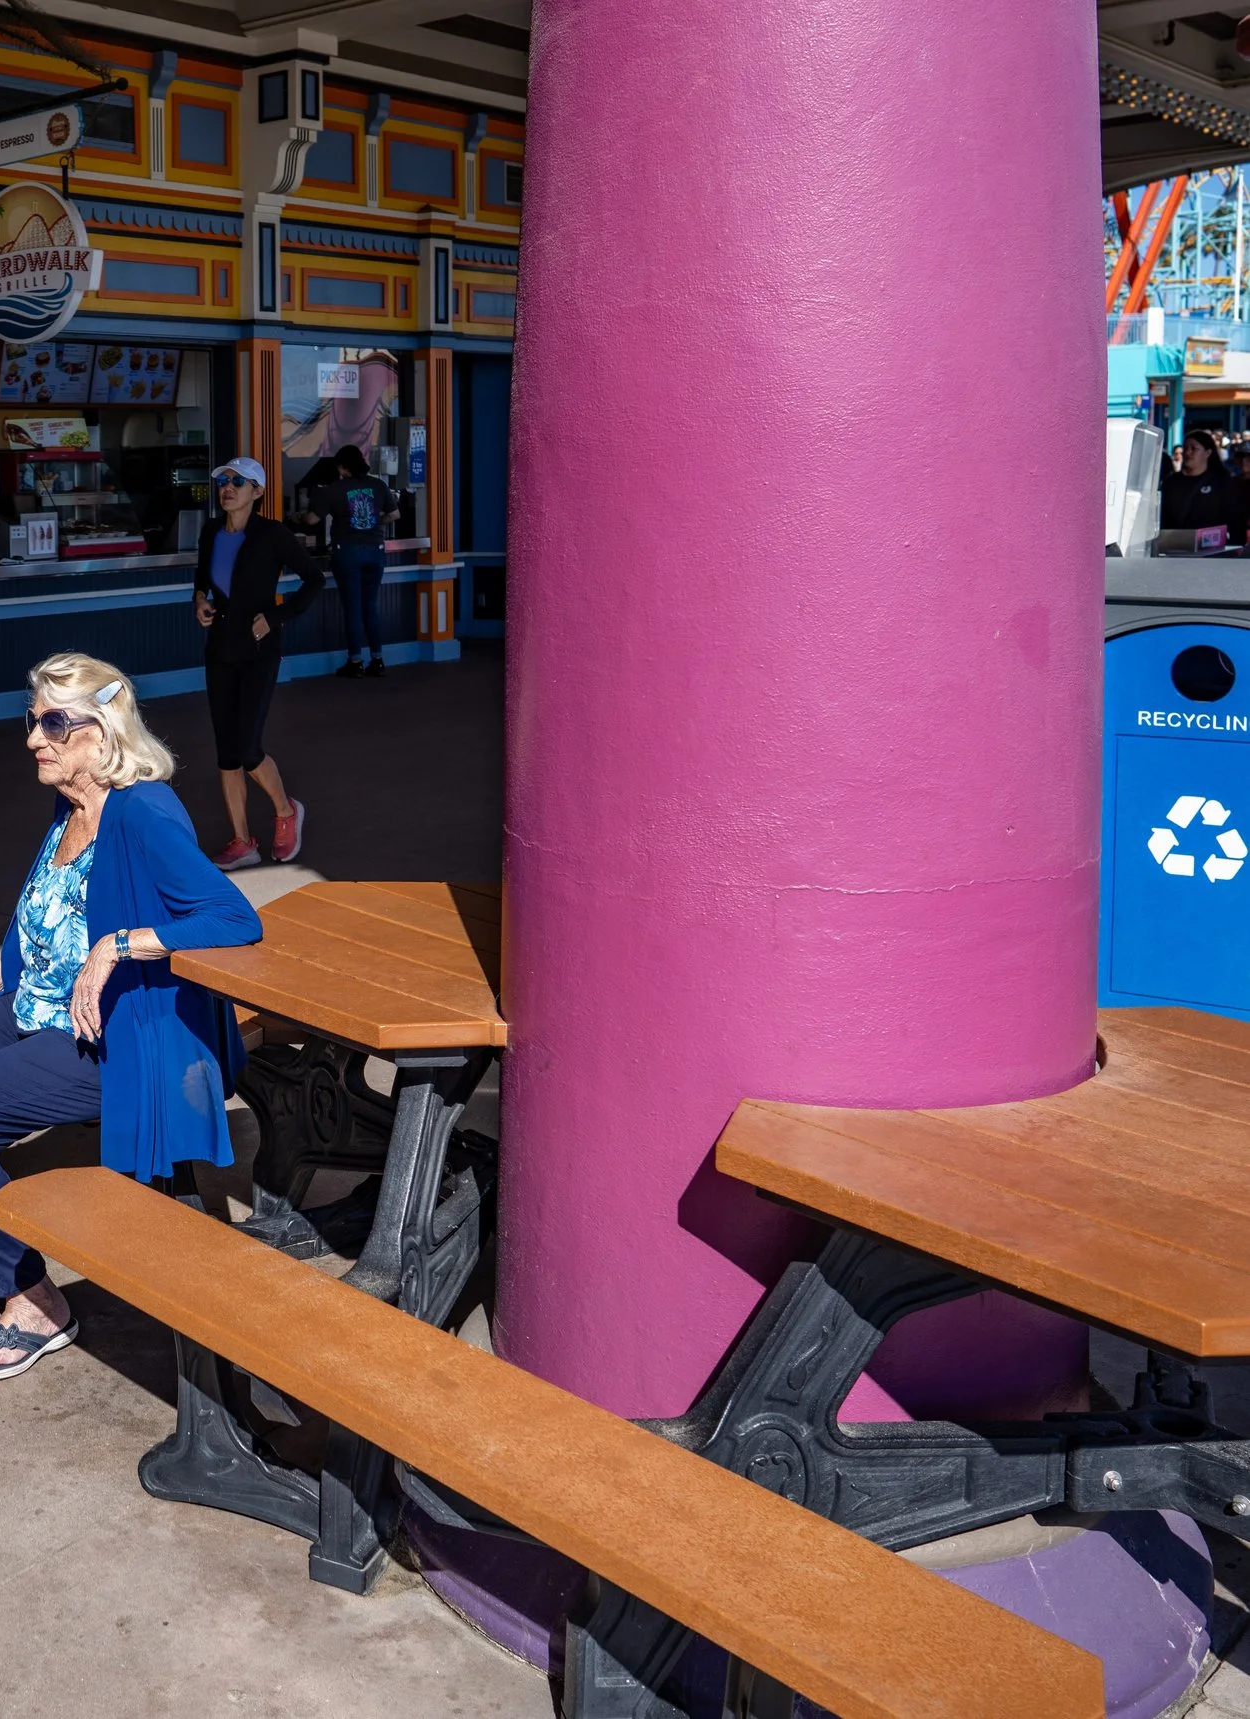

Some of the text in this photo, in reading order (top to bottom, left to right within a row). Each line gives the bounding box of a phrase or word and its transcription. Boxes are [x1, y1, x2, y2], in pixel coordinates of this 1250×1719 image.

[0, 133, 35, 149] ESPRESSO
[320, 370, 357, 384] PICK-UP
[1137, 710, 1250, 732] RECYCLIN
